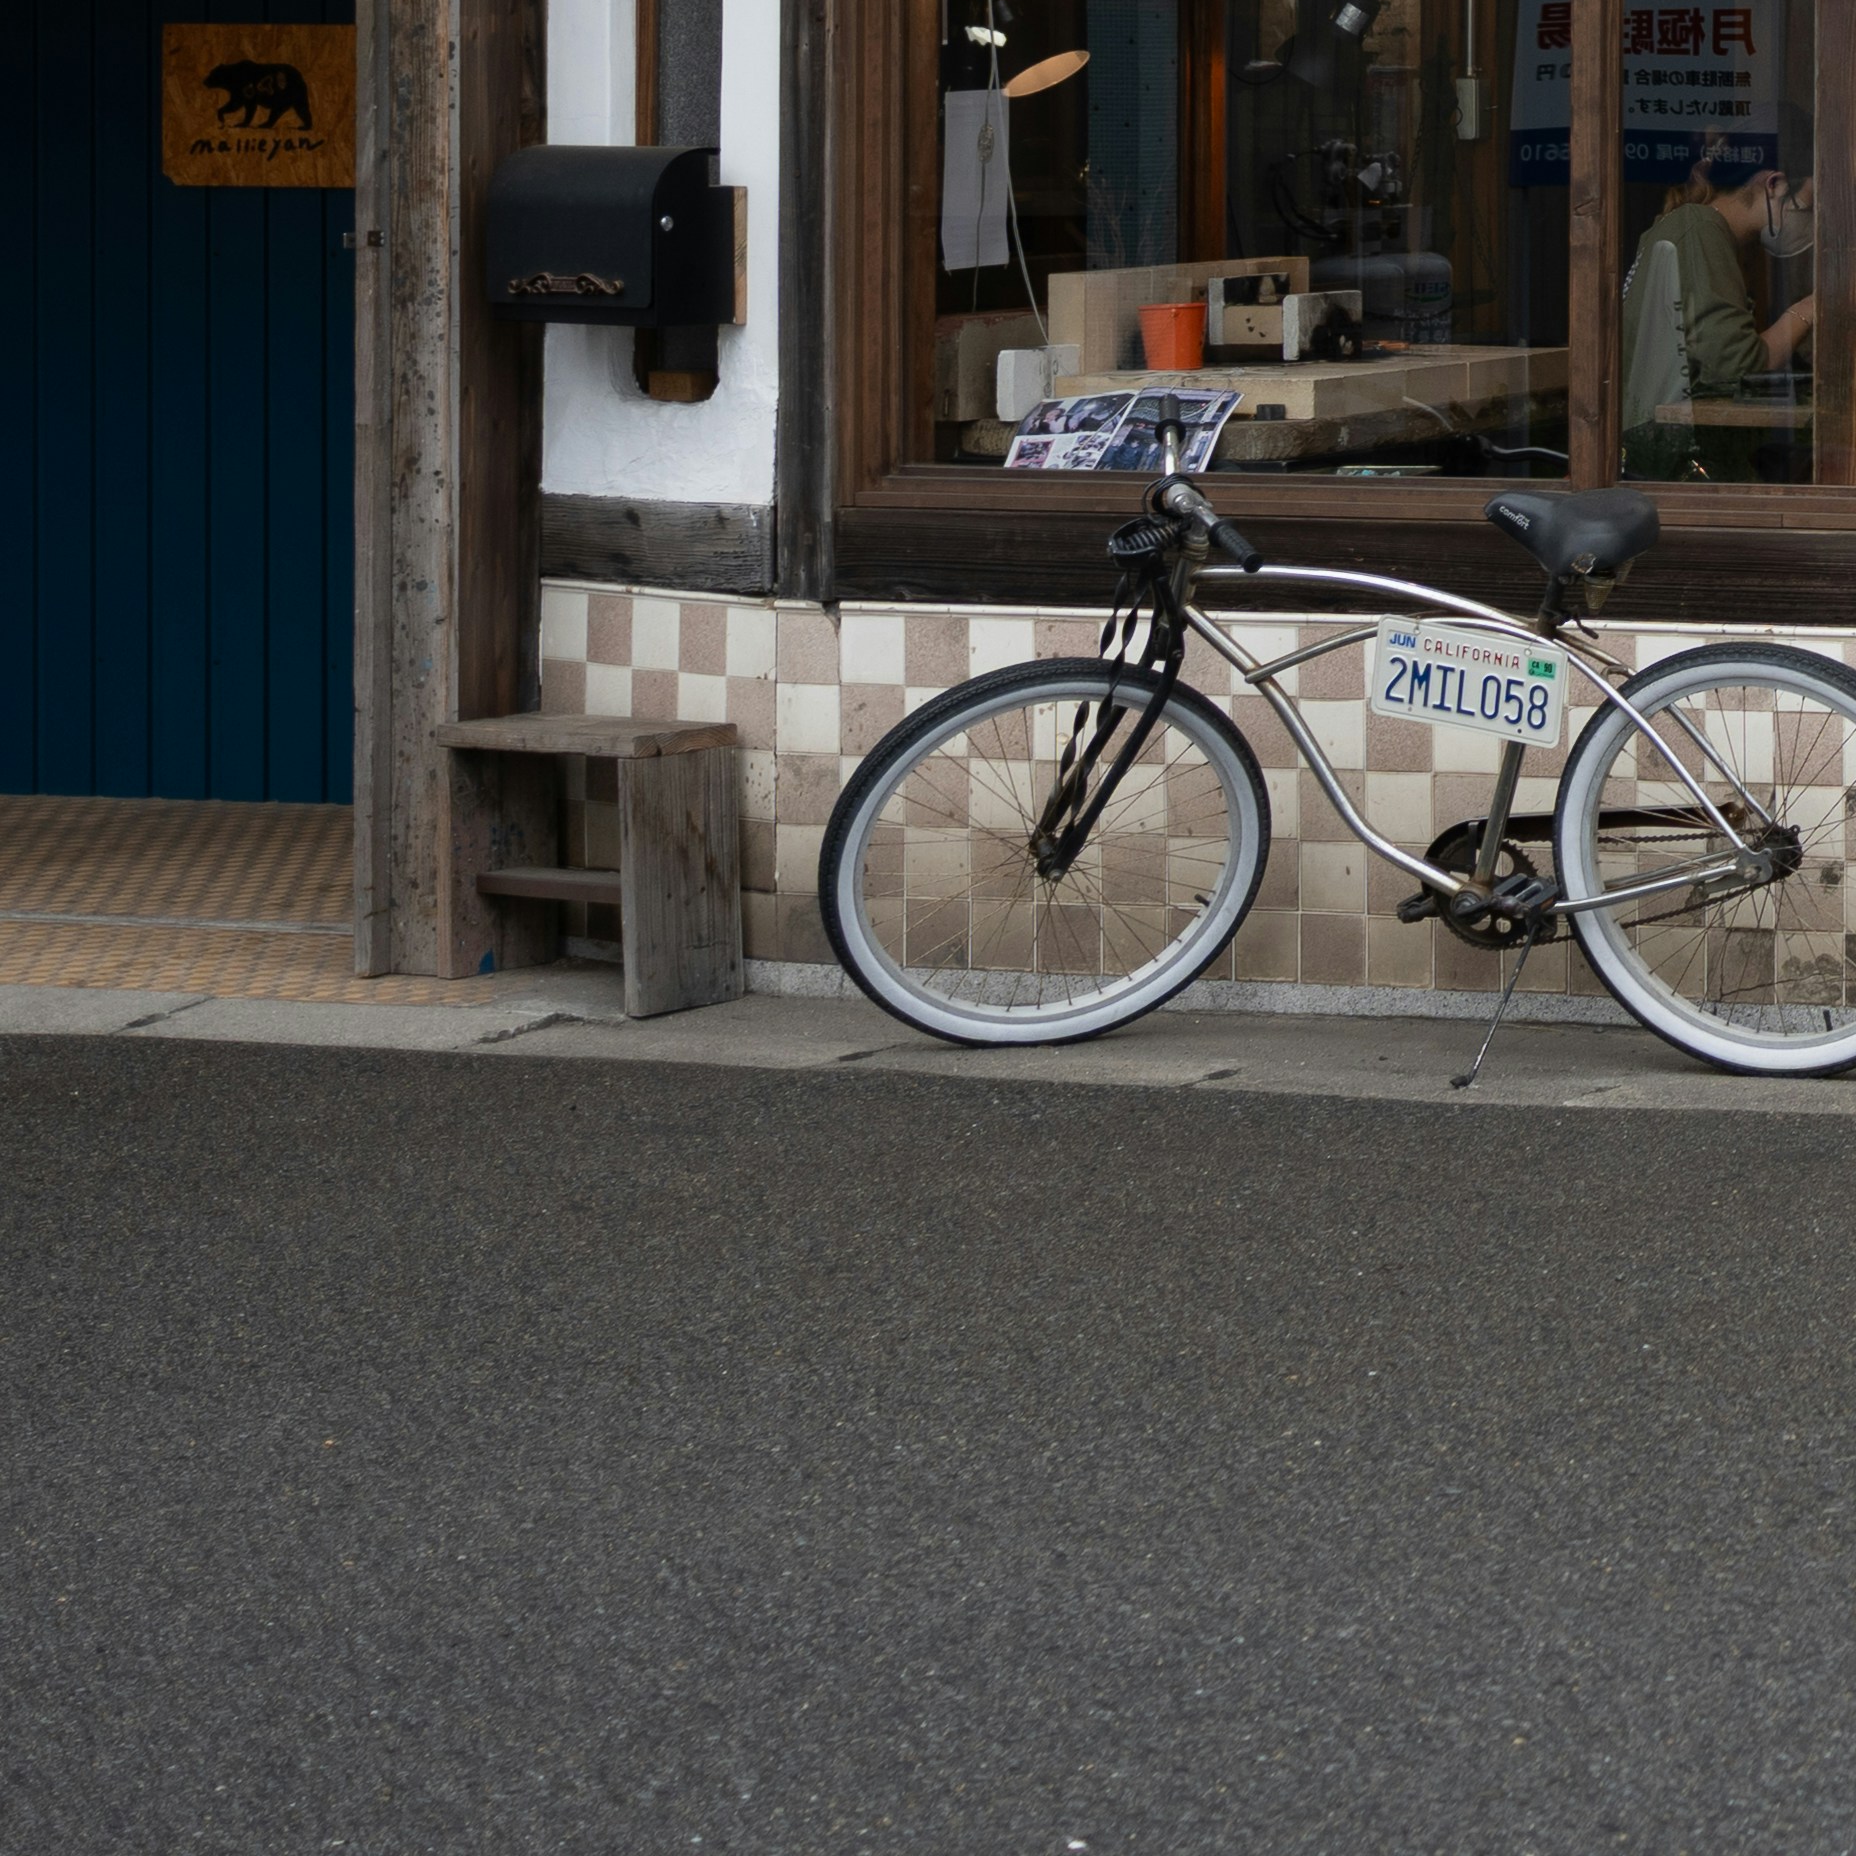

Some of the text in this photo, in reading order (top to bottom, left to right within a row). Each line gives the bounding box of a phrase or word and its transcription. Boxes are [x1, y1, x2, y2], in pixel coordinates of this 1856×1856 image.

[189, 138, 325, 162] mallieyan
[1498, 505, 1530, 531] comfort
[1389, 633, 1521, 670] JUN CALIFORNIA
[1385, 656, 1549, 731] 2MIL058
